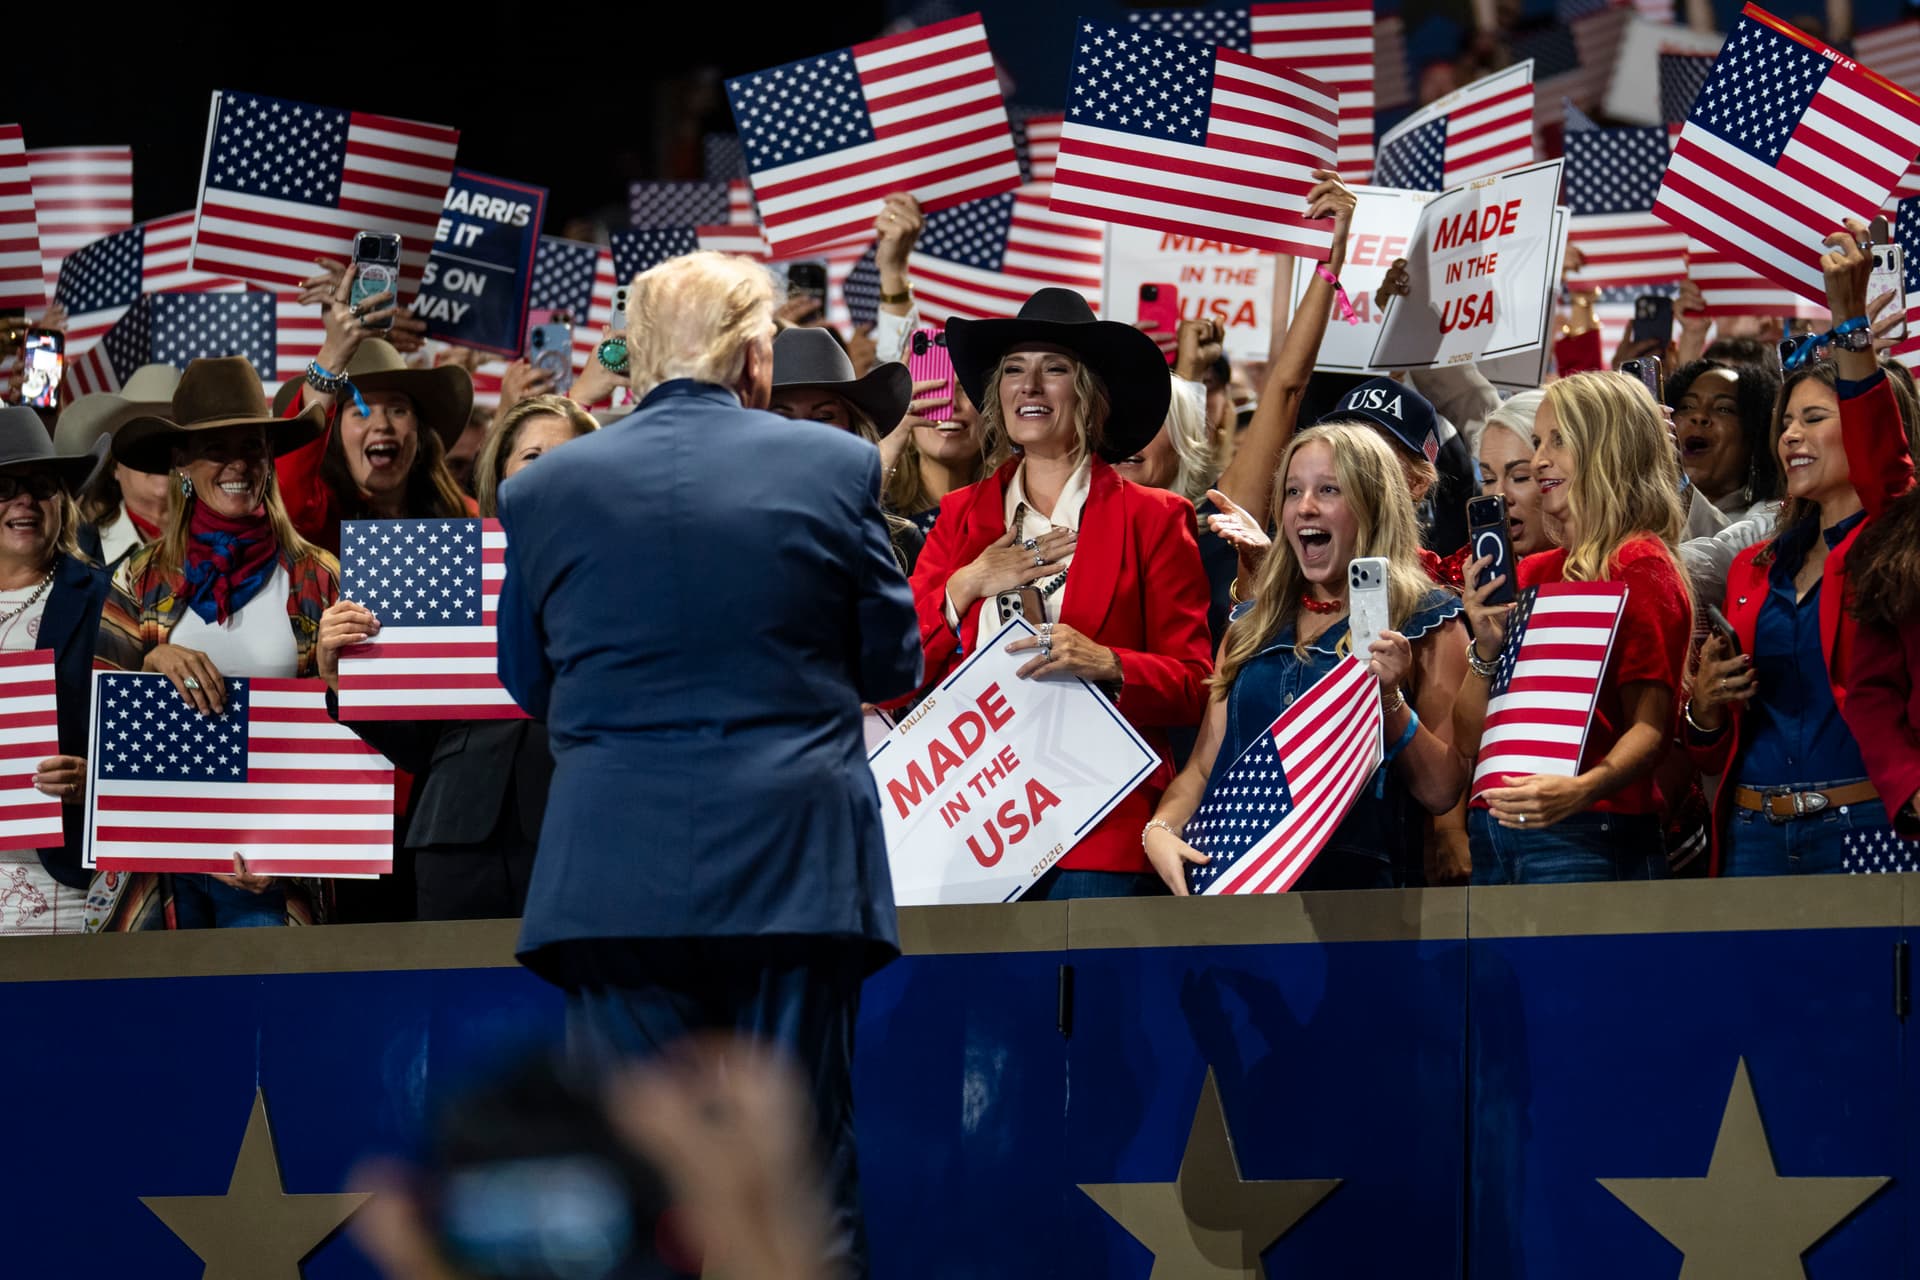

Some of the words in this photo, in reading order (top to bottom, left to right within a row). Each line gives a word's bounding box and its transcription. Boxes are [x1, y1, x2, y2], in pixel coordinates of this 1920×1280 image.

[453, 223, 484, 247] IT
[1433, 199, 1522, 253] MADE
[443, 268, 487, 297] ON
[1180, 265, 1205, 283] IN
[1213, 267, 1258, 286] THE
[1445, 261, 1462, 285] IN
[1467, 252, 1498, 279] THE
[1180, 298, 1257, 329] USA
[1439, 290, 1494, 335] USA
[1348, 388, 1403, 421] USA
[898, 696, 937, 736] DALLAS
[886, 681, 1016, 821] MADE
[939, 791, 971, 829] IN
[967, 744, 1021, 799] THE
[966, 777, 1062, 868] USA
[1030, 843, 1065, 878] 2026
